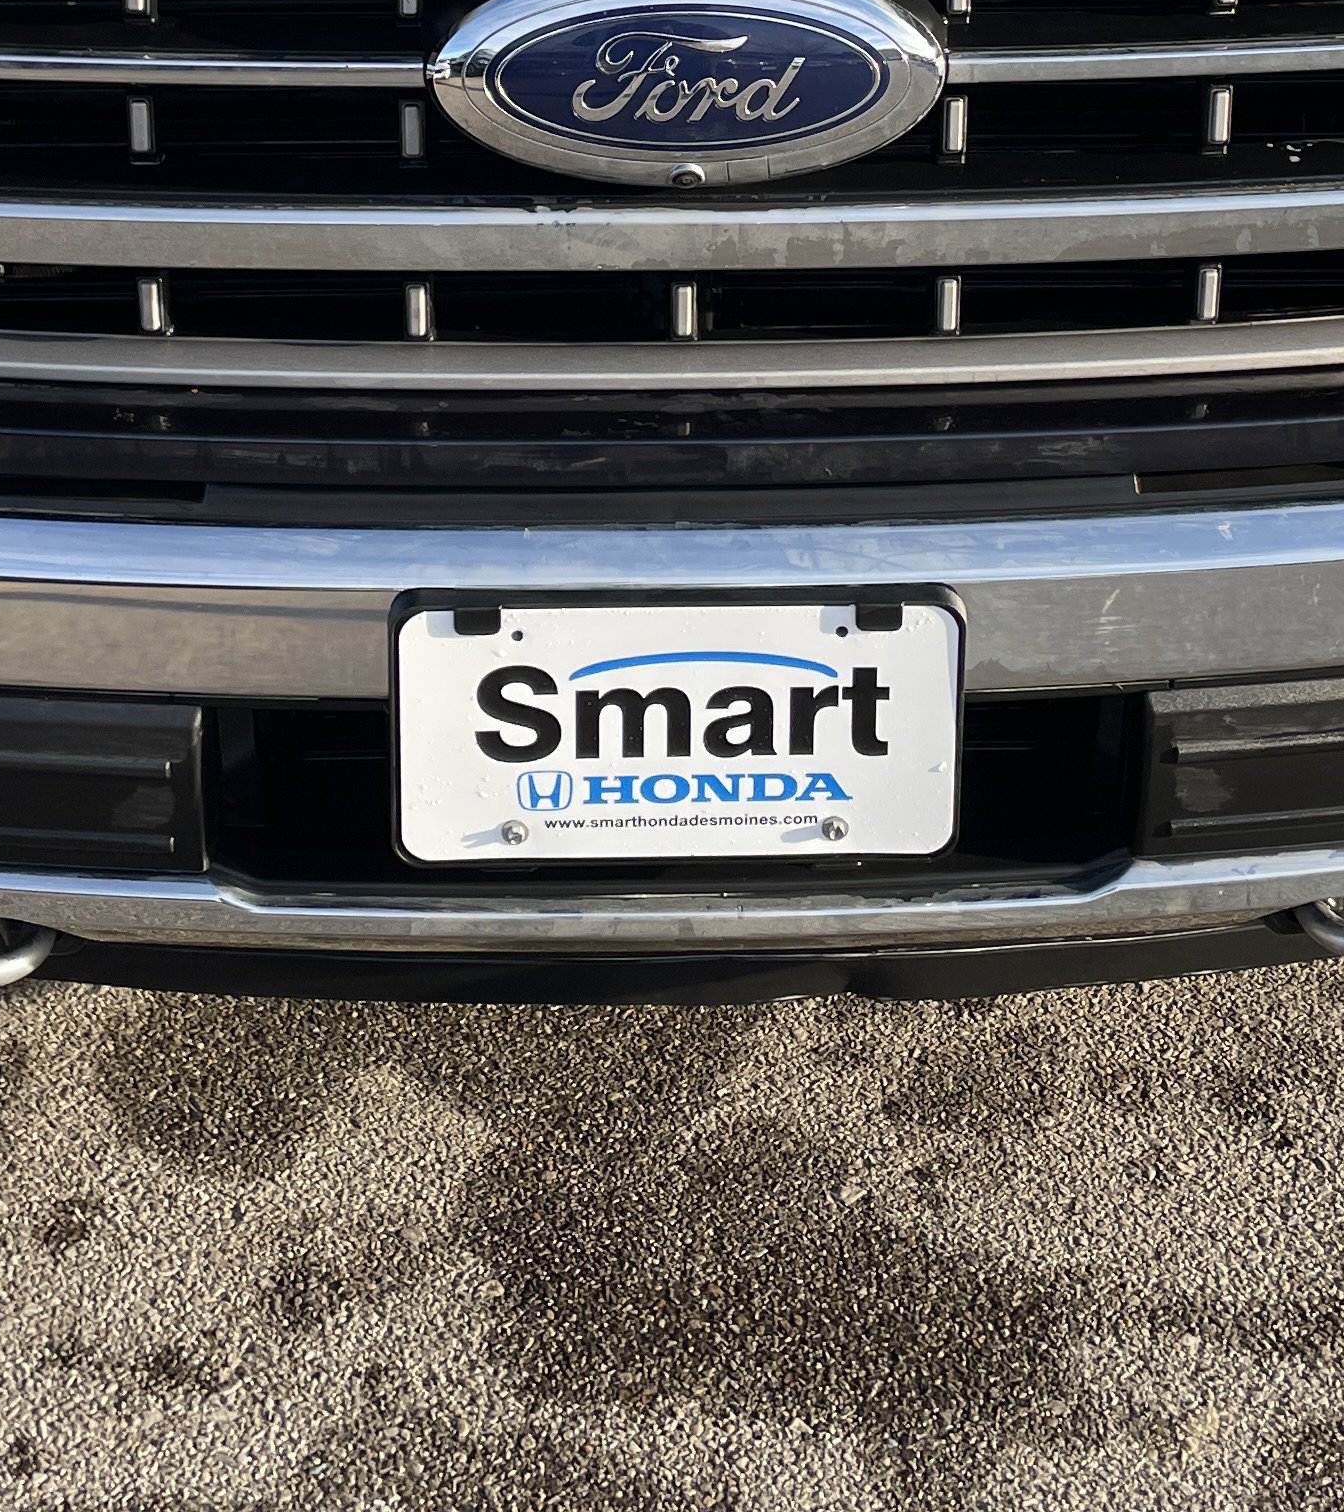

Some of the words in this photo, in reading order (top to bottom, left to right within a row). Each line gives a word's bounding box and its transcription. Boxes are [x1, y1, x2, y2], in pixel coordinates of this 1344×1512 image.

[573, 31, 806, 123] Ford
[474, 664, 891, 763] Smart
[582, 773, 853, 805] HONDA
[543, 813, 818, 829] www.smarthondadesmoines.com
